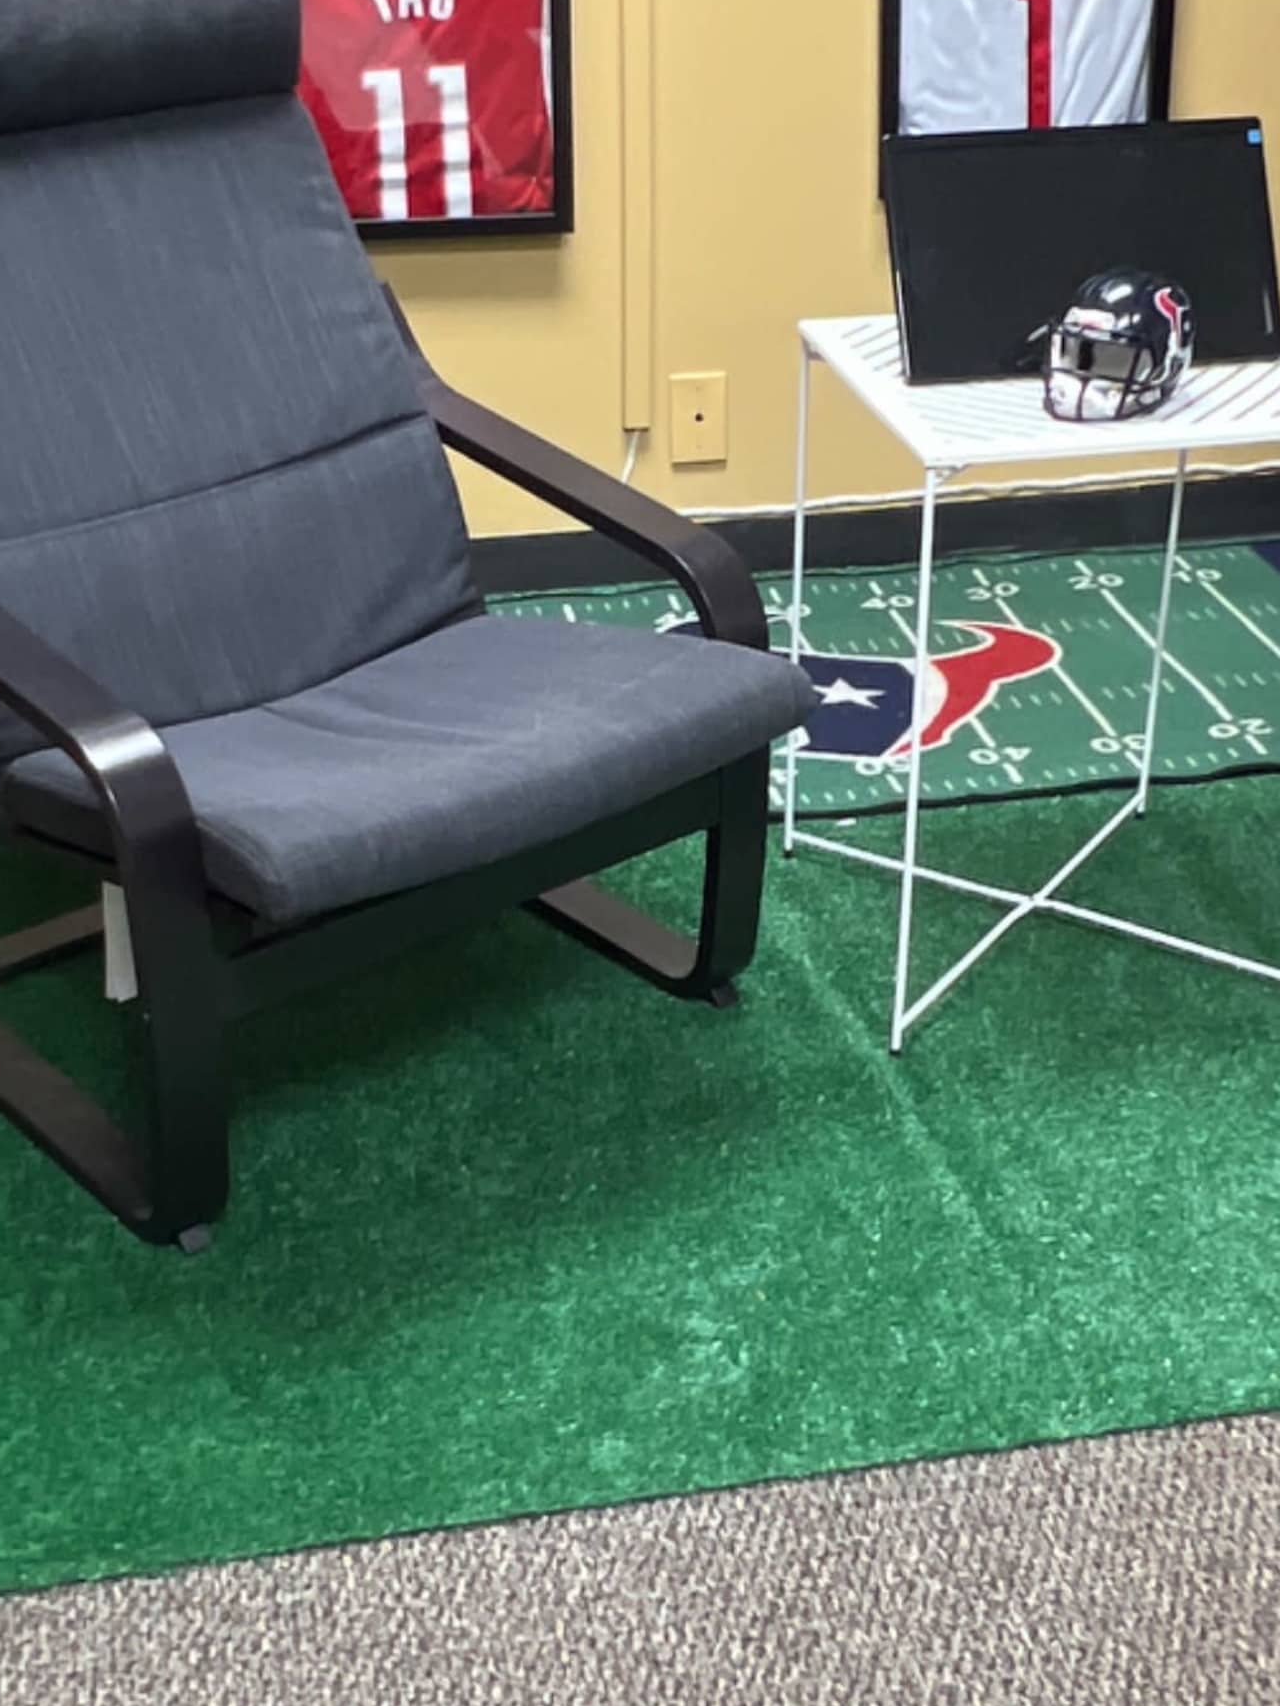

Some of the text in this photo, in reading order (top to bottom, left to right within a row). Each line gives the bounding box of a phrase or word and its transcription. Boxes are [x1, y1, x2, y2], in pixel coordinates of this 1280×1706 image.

[361, 63, 472, 219] 11
[1067, 572, 1125, 591] 20
[860, 595, 915, 611] 40
[1207, 718, 1274, 740] 20
[968, 745, 1033, 766] 40
